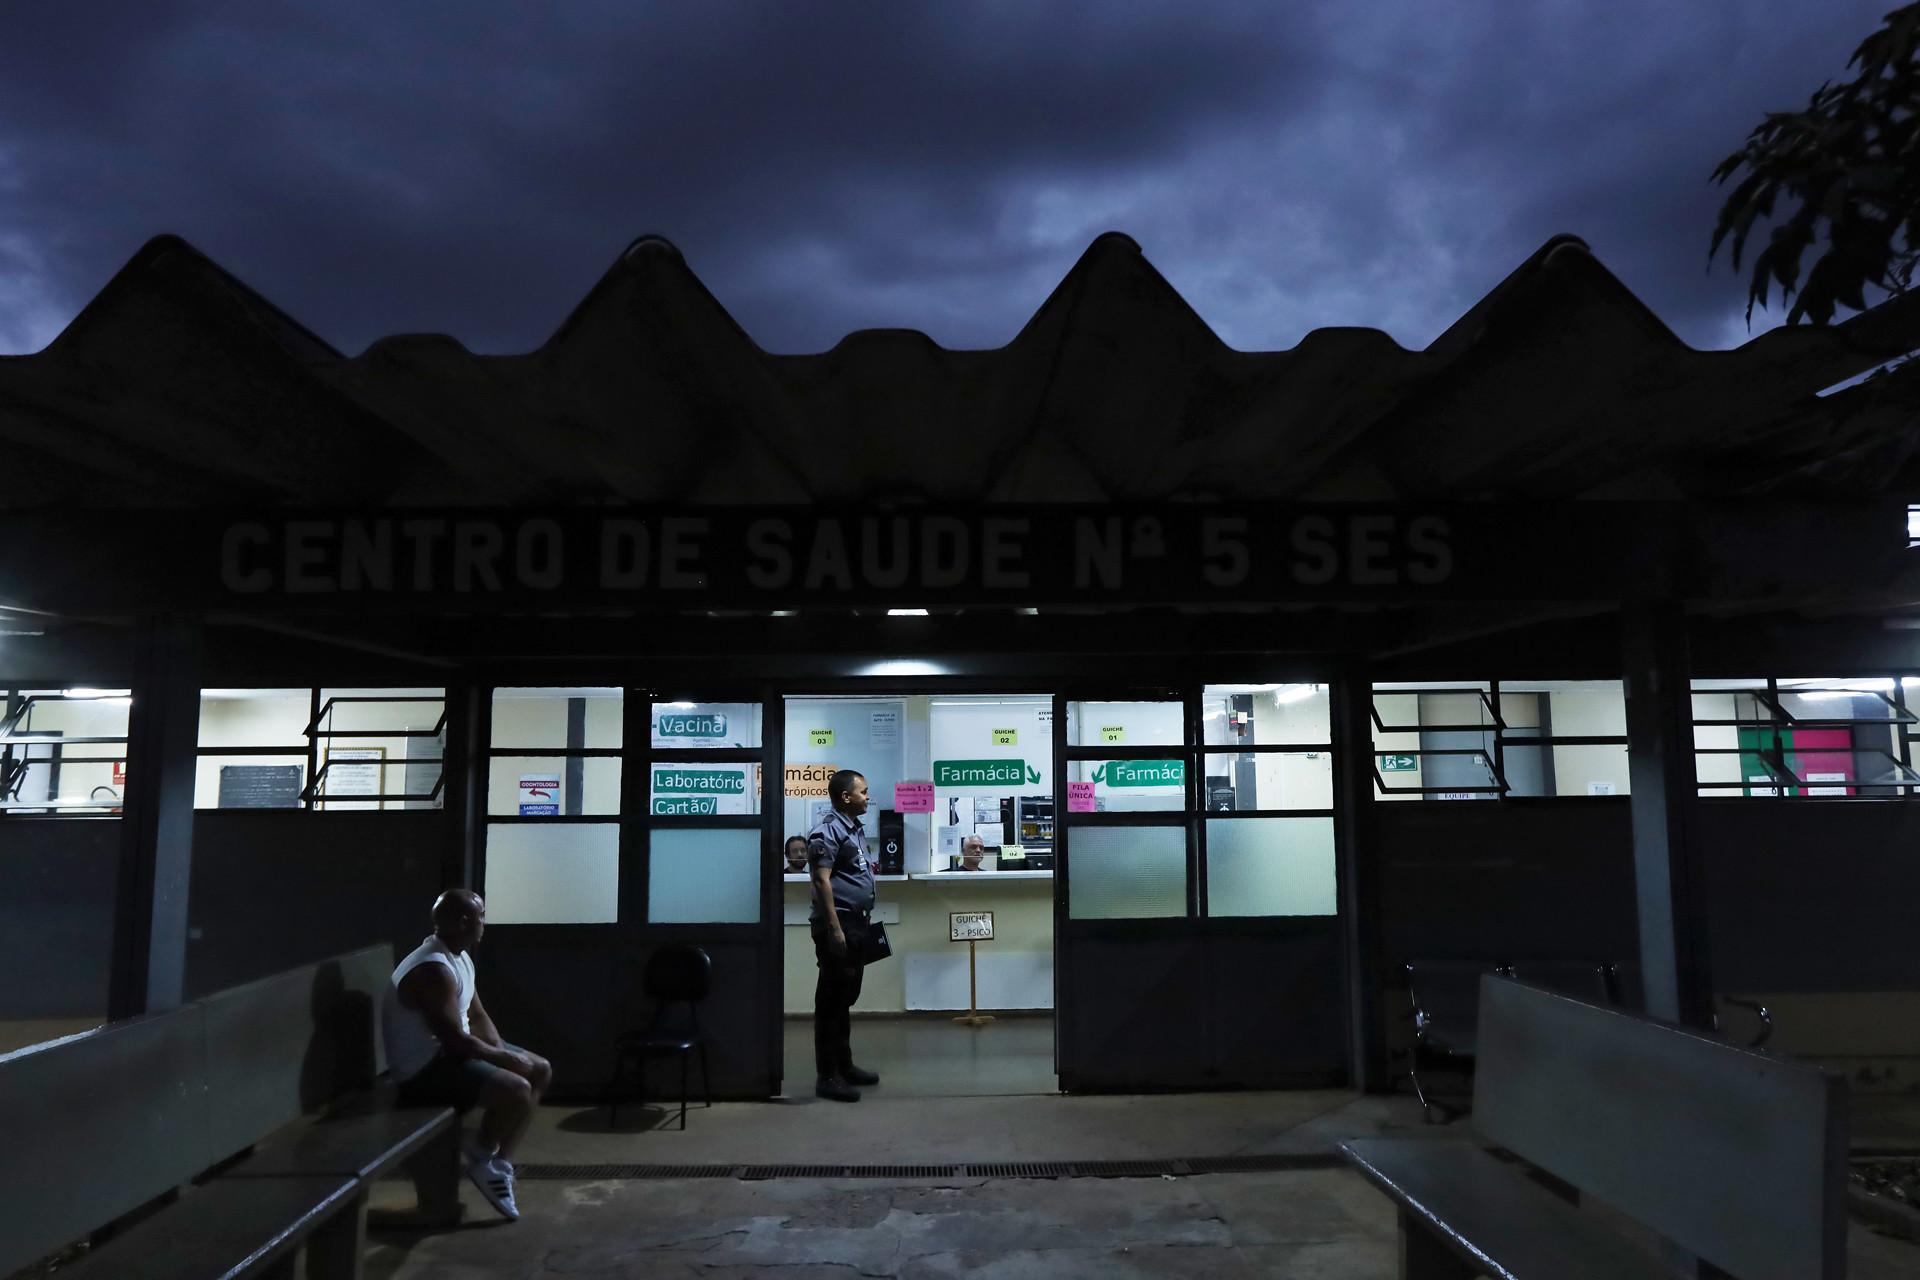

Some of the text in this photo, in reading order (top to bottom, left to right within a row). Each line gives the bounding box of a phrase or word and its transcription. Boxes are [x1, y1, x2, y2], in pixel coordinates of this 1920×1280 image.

[220, 518, 566, 593] CENTRO
[600, 516, 710, 590] DE
[1202, 516, 1250, 587] 5
[1290, 515, 1454, 585] SES
[661, 717, 724, 733] Vacina
[941, 764, 1020, 782] Farmácia
[1116, 763, 1184, 781] Farmáci
[656, 773, 745, 790] Laboratório
[953, 928, 959, 938] 3
[967, 928, 991, 937] PSICO
